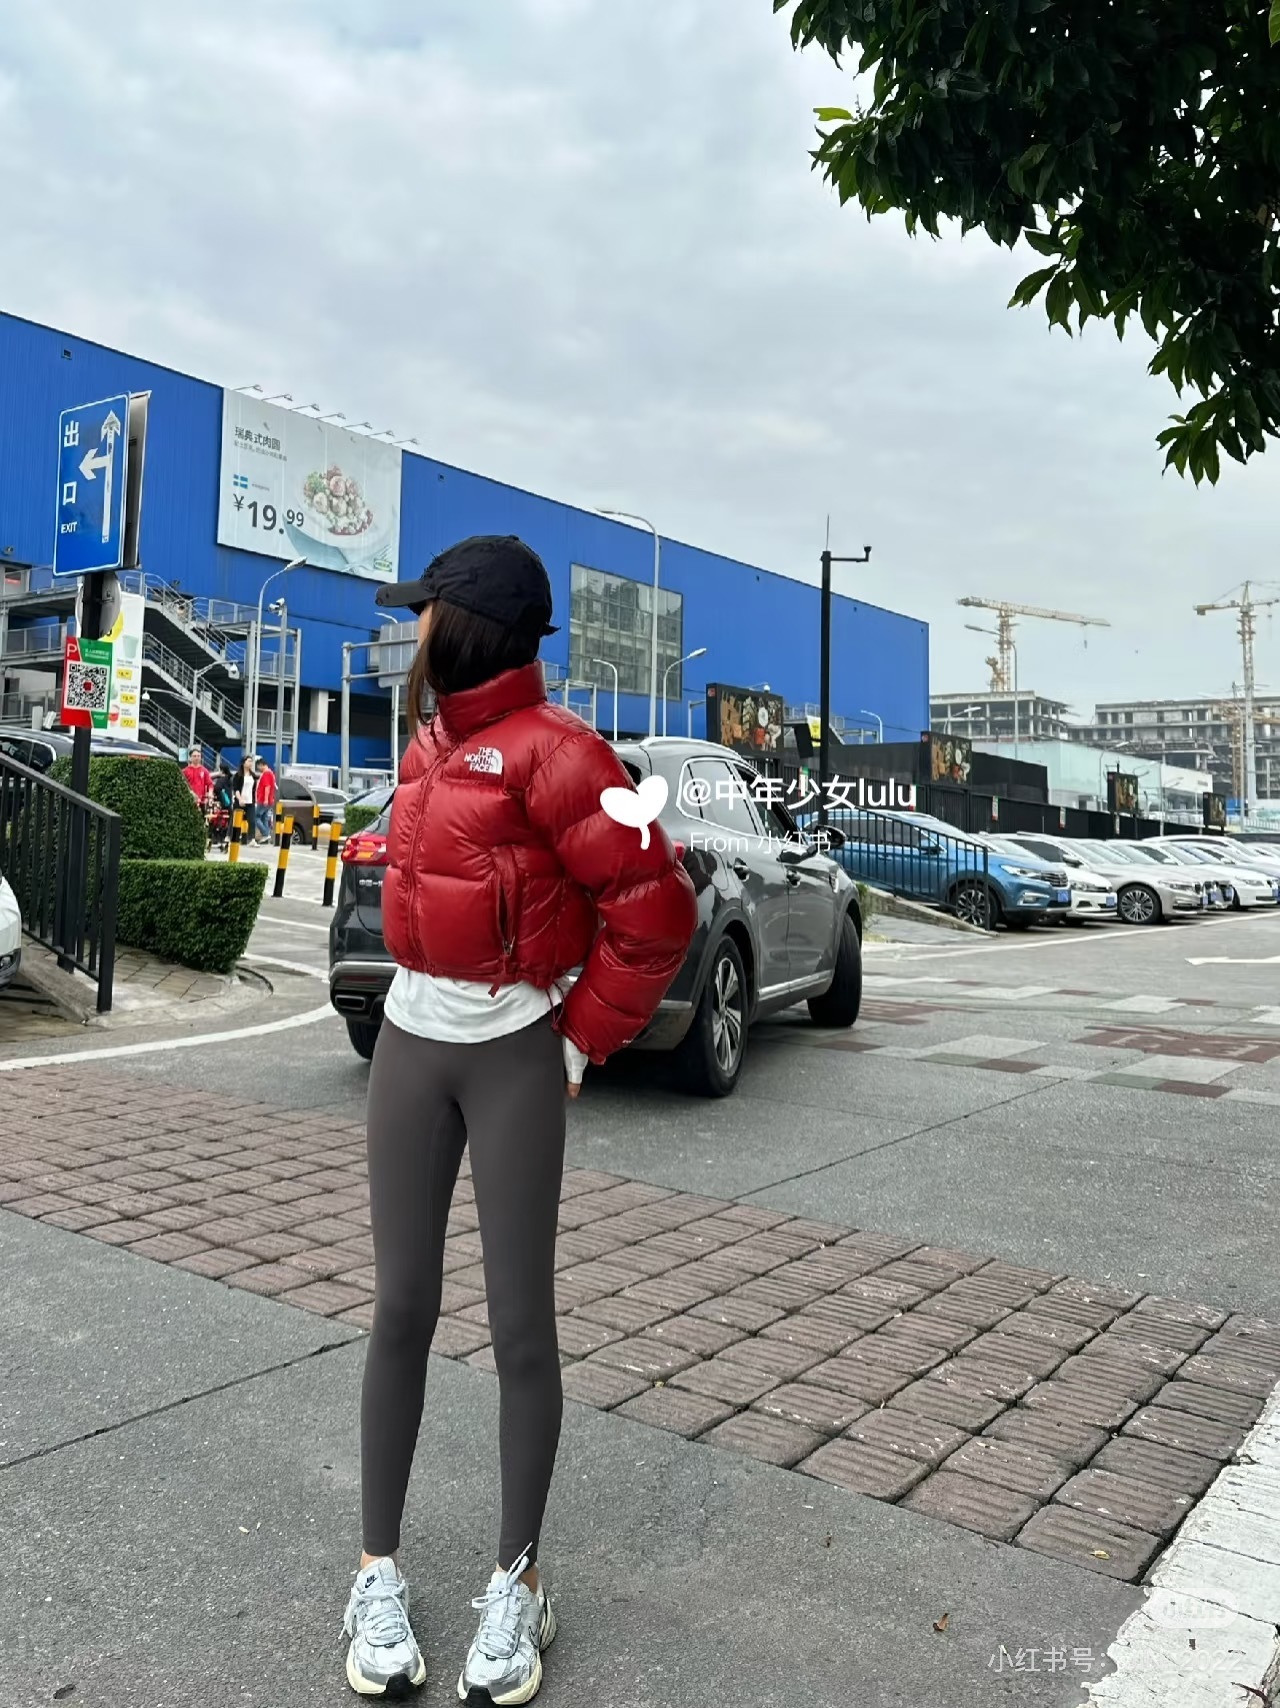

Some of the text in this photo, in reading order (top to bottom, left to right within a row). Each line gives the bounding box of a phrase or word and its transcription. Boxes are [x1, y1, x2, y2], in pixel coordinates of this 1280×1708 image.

[62, 420, 79, 506] 出口
[61, 521, 77, 534] EXIT
[66, 643, 78, 657] P
[478, 746, 493, 756] THE
[464, 753, 492, 764] NORTH
[469, 763, 490, 772] FACE
